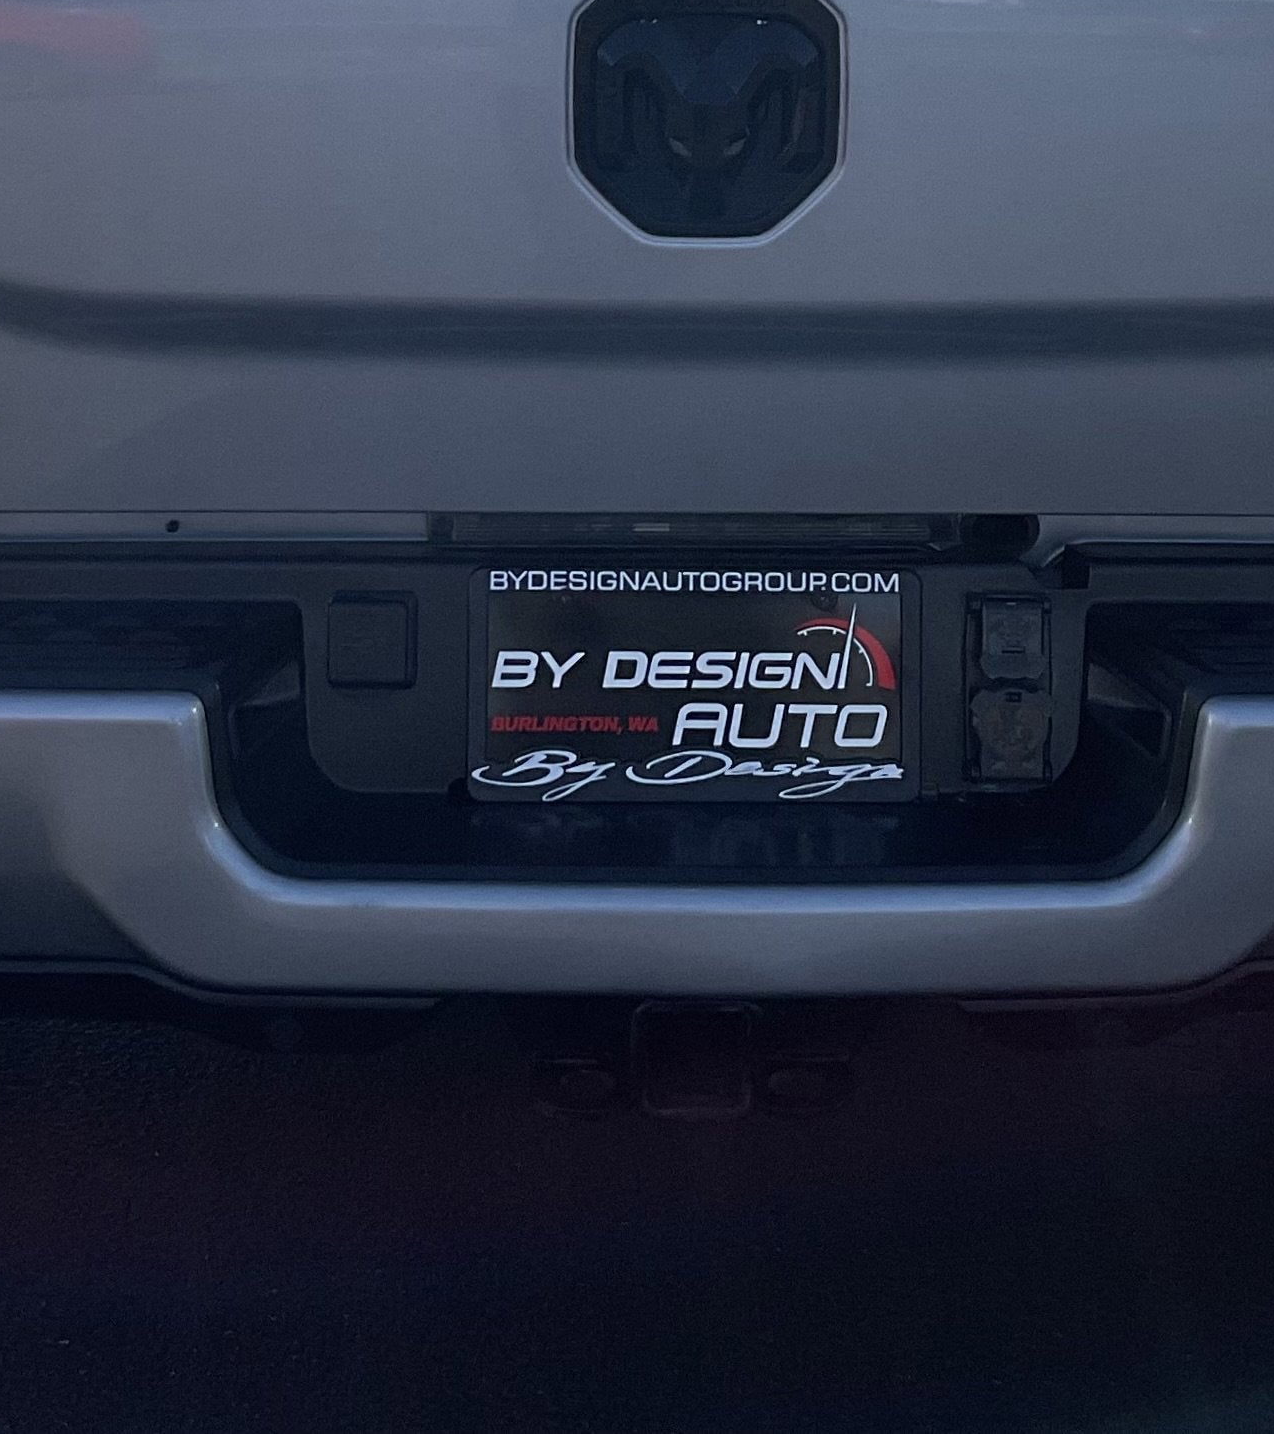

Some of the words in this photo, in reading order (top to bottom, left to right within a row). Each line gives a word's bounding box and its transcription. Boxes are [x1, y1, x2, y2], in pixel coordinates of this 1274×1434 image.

[488, 570, 900, 593] BYDESIGNAUTOGROUP.COM
[491, 650, 585, 689] BY
[602, 650, 847, 690] DESIGN
[490, 715, 623, 735] BURLINGTON,
[627, 715, 659, 732] WA
[671, 702, 888, 749] AUTO
[471, 749, 617, 802] By
[625, 750, 904, 799] Design
